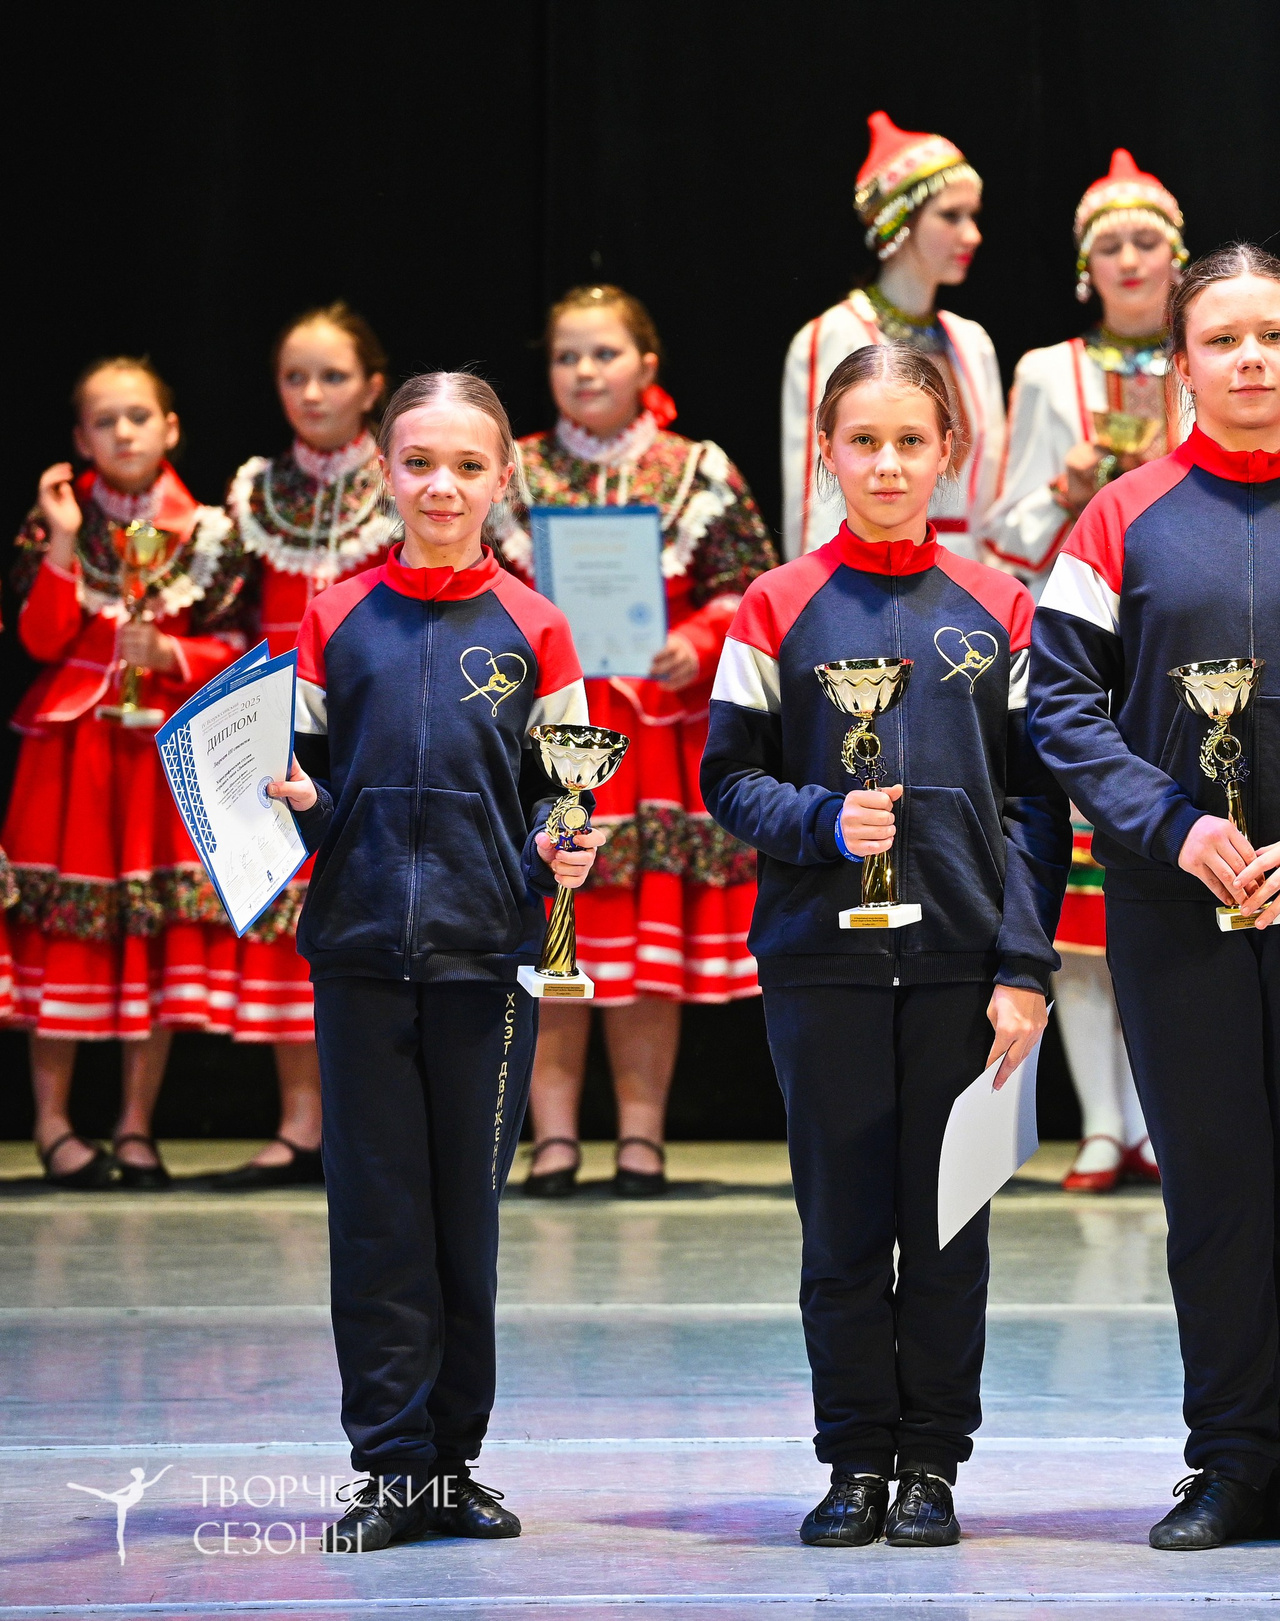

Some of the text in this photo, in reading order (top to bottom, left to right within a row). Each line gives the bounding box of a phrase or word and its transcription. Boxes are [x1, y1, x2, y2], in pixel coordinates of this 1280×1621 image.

[240, 694, 261, 712] 2025
[206, 710, 258, 756] ДИПЛОМ
[503, 992, 517, 1056] ХСЭТ
